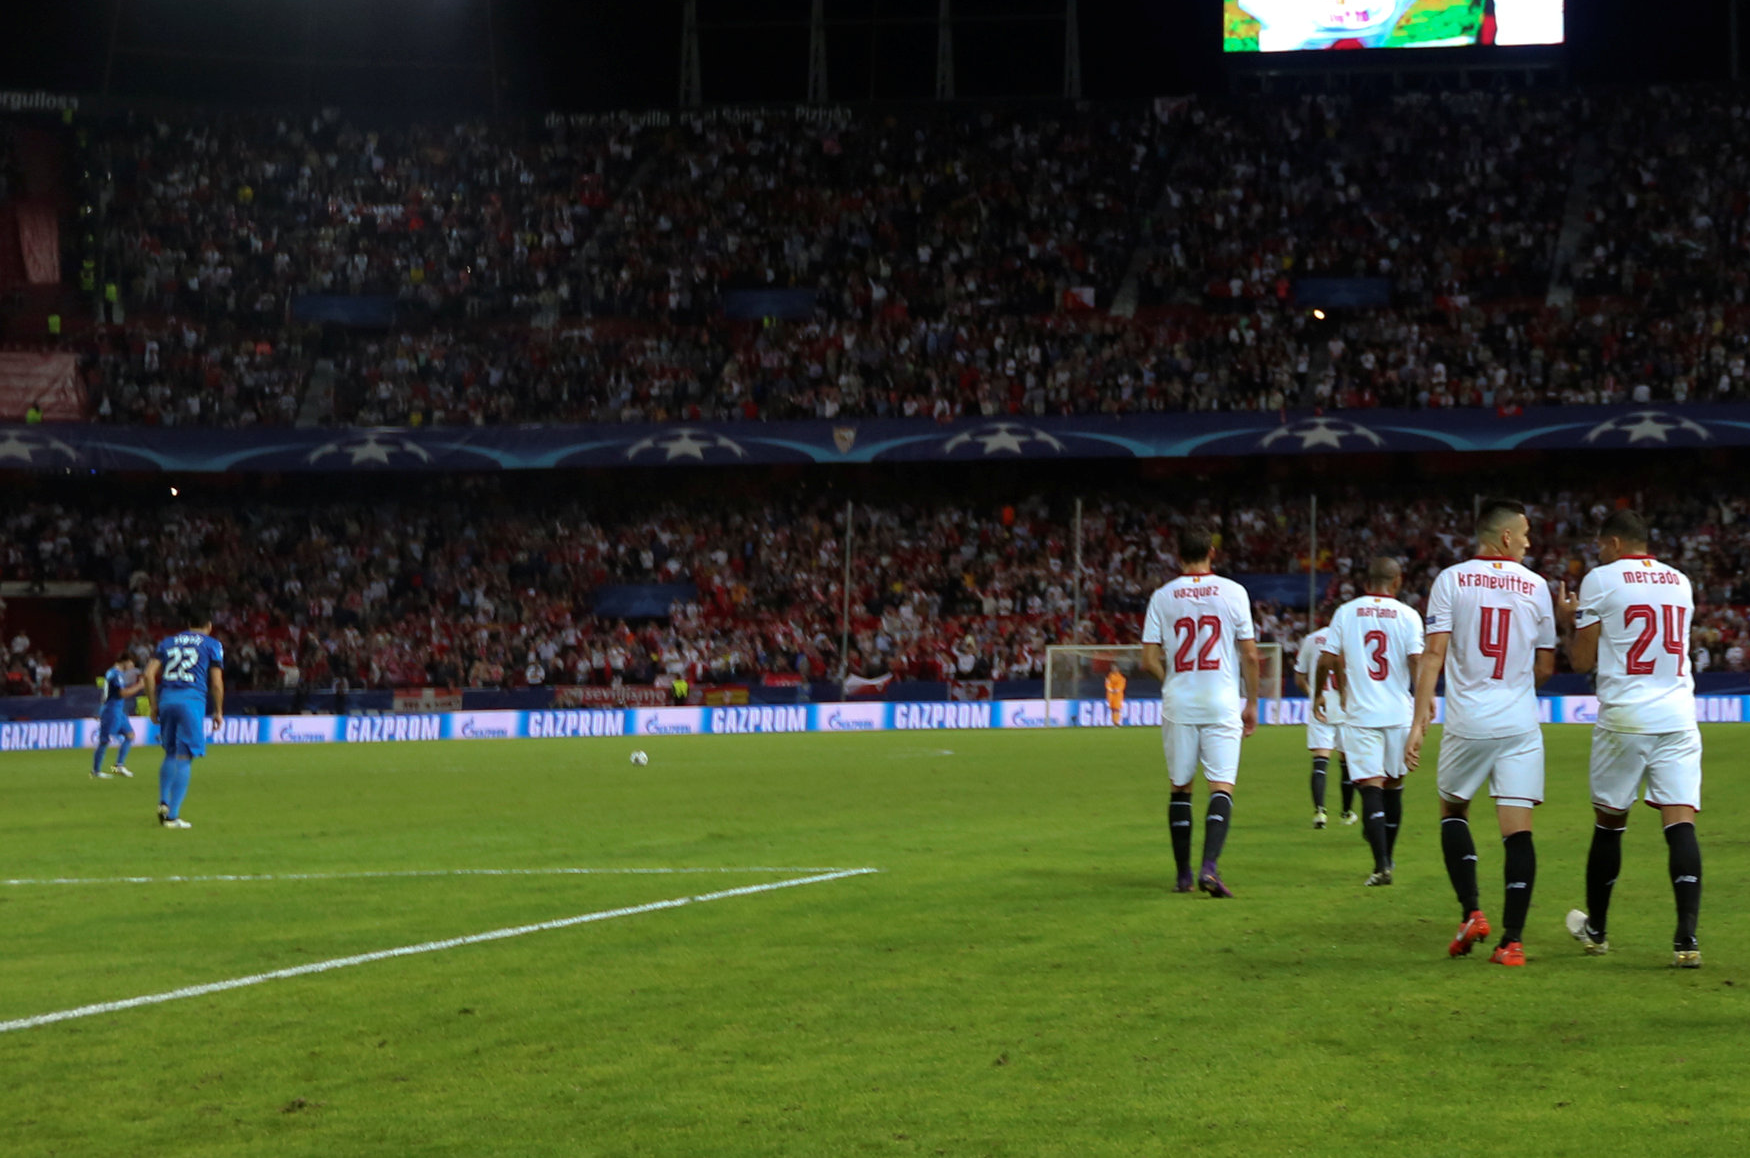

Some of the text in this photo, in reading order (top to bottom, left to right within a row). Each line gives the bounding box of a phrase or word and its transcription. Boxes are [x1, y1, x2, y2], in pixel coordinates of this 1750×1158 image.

[1174, 615, 1221, 673] 22
[1479, 606, 1512, 680] 4
[1623, 604, 1686, 677] 24
[164, 647, 198, 682] 22
[1364, 630, 1389, 681] 3
[528, 710, 624, 737] GAZPROM
[711, 706, 807, 733] GAZPROM
[894, 702, 991, 729] GAZPROM
[1079, 698, 1162, 727] GAPRO
[1, 722, 75, 749] GAZPROM
[204, 717, 260, 744] PROM
[346, 714, 441, 742] GAZPROM
